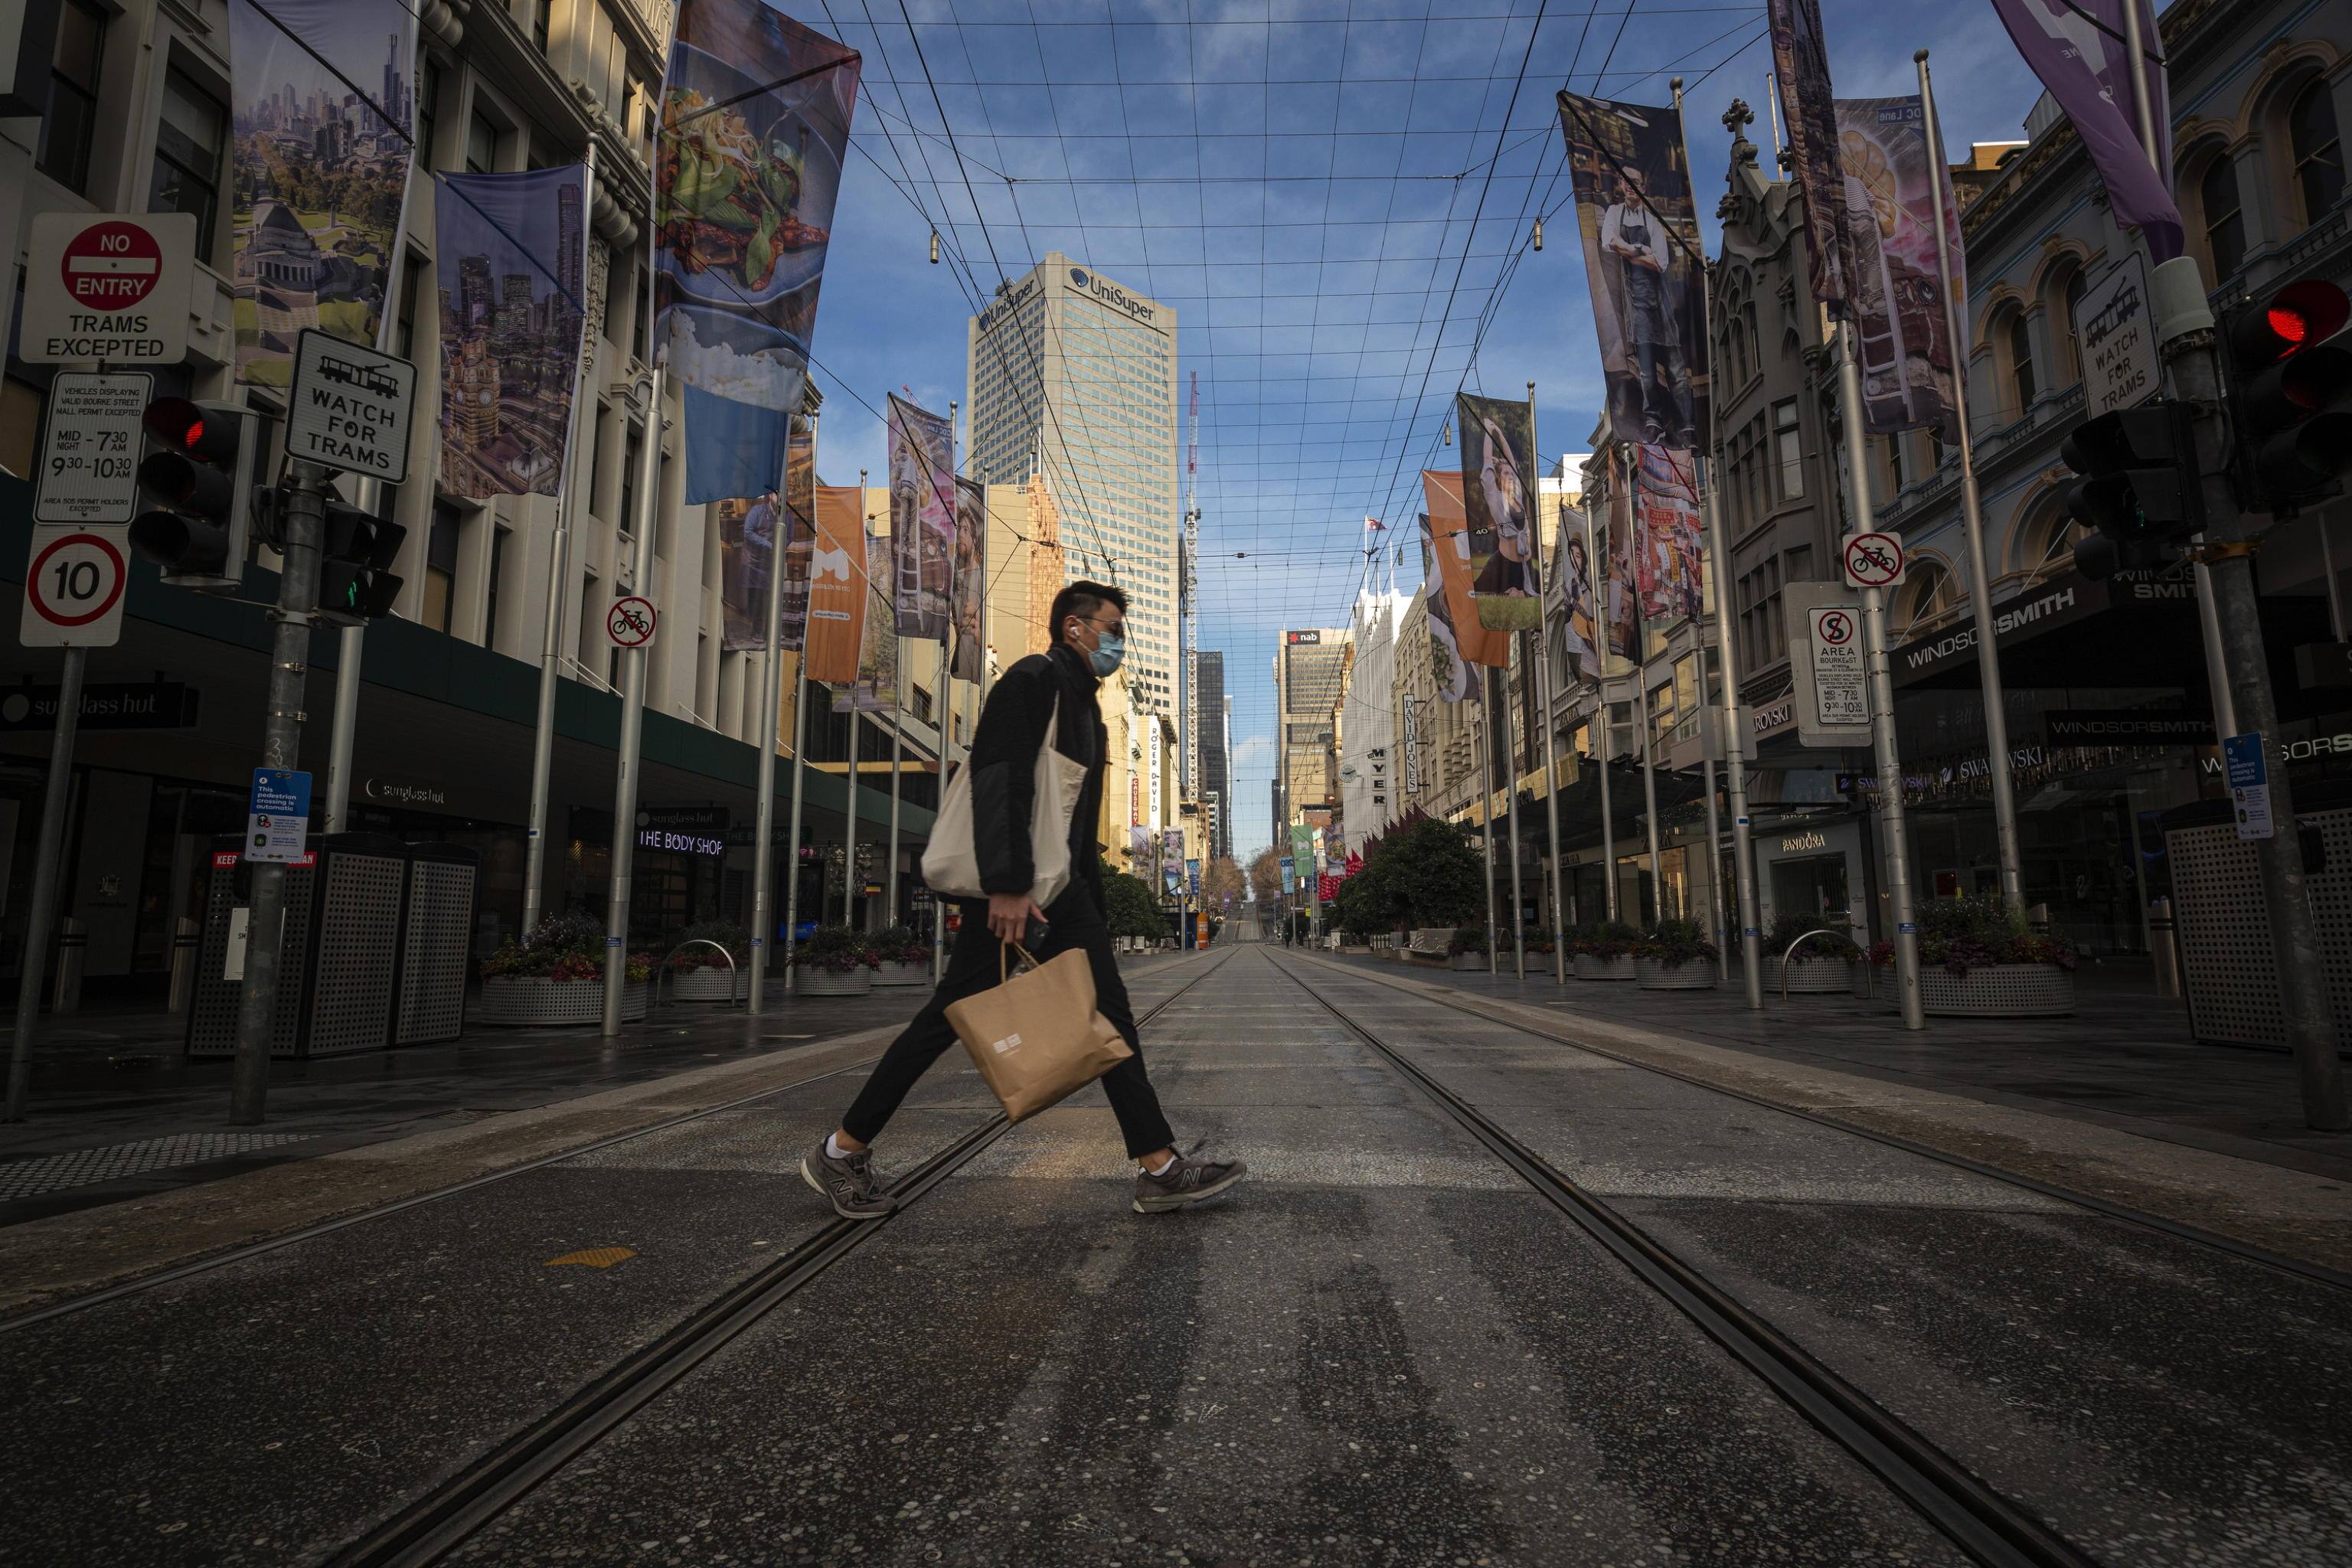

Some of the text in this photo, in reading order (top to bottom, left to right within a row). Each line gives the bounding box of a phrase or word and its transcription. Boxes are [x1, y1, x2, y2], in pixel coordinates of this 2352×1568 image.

[100, 234, 130, 253] NO
[76, 277, 147, 296] ENTRY
[990, 279, 1034, 323] UniSuper
[1089, 275, 1154, 321] UniSuper
[69, 315, 149, 333] TRAMS
[47, 338, 164, 357] EXCEPTED
[2096, 328, 2138, 371] WATCH
[2107, 357, 2132, 384] FOR
[100, 388, 139, 397] DISPLAYING
[2100, 370, 2145, 411] TRAMS
[78, 408, 103, 416] PERMIT
[312, 387, 396, 428] WATCH
[57, 430, 81, 442] MID
[328, 416, 377, 445] FOR
[57, 442, 126, 452] NIGHT AM
[307, 432, 391, 470] TRAMS
[114, 470, 130, 479] AM
[54, 560, 100, 600] 10
[1300, 632, 1317, 642] nab
[1821, 647, 1855, 656] AREA
[123, 693, 157, 713] hut
[1406, 700, 1416, 789] DAVID JONES
[1372, 749, 1386, 804] MYER
[257, 792, 296, 801] pedestrian
[384, 785, 427, 802] sunglass
[652, 812, 713, 826] sunglass hut
[640, 831, 723, 856] THE BODY SHOP
[1782, 831, 1825, 852] PANDORA
